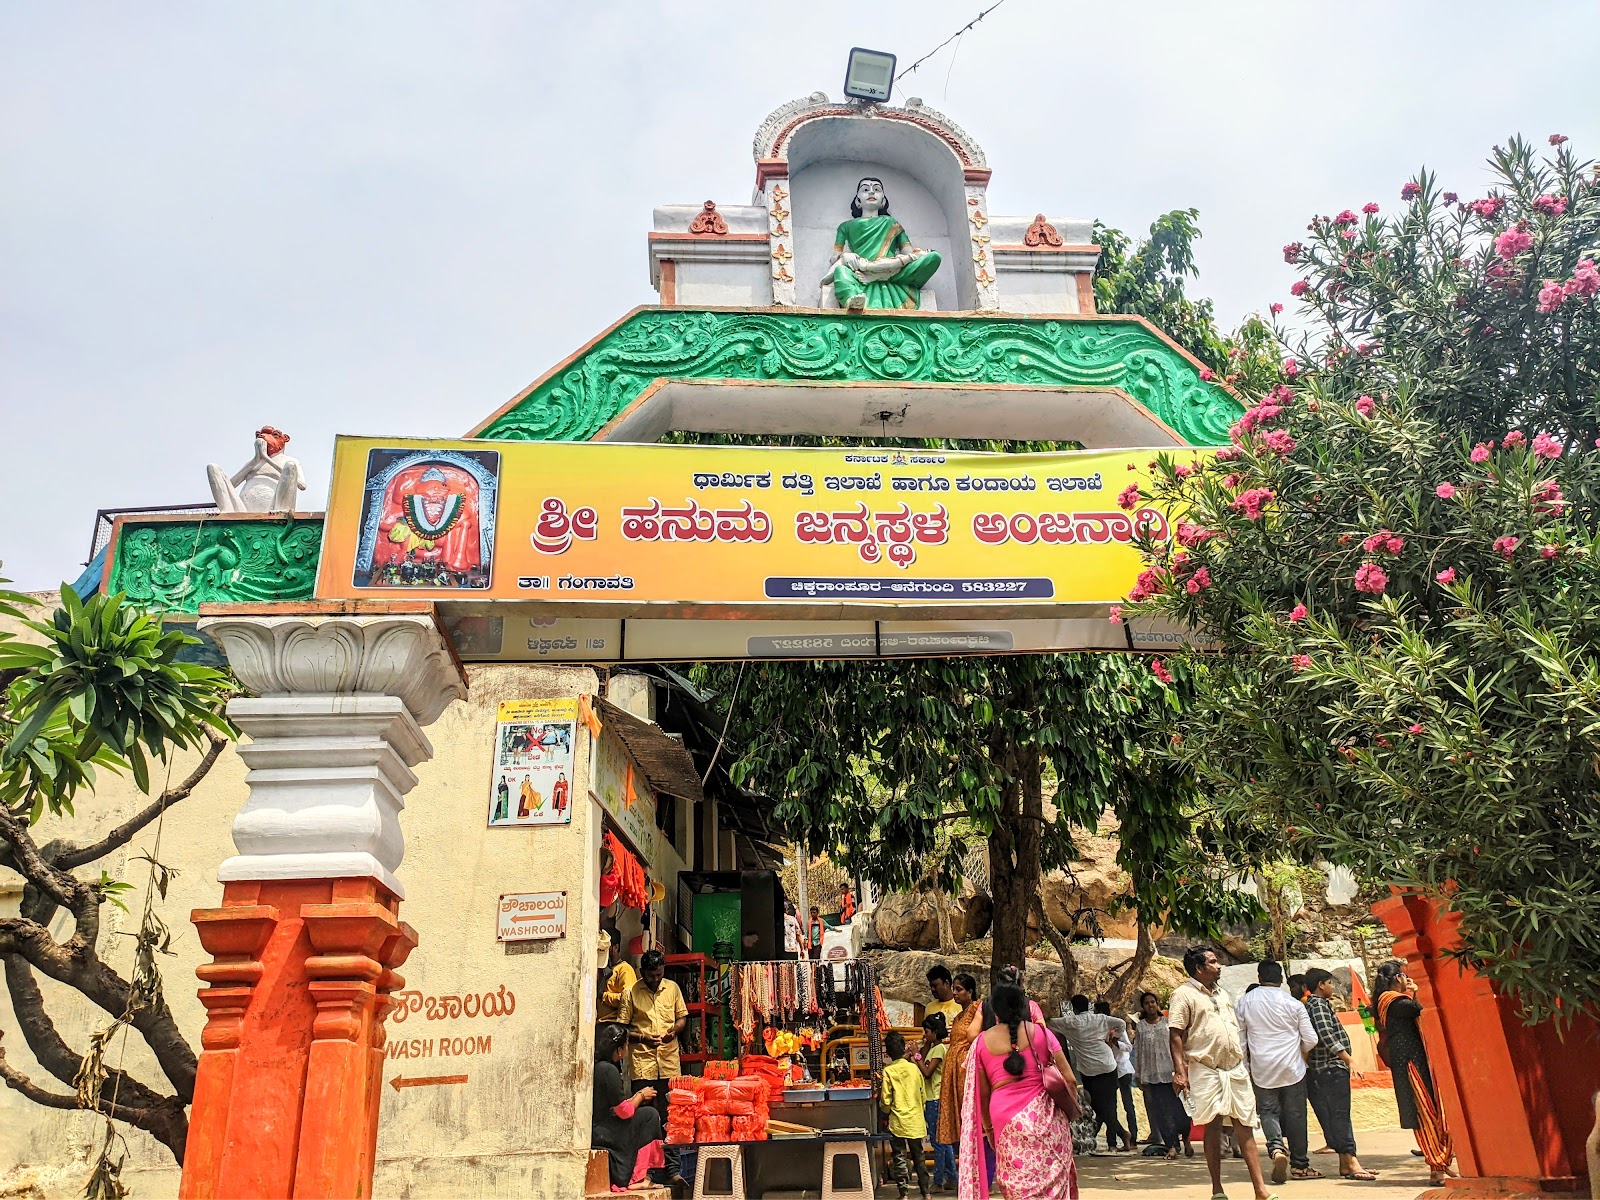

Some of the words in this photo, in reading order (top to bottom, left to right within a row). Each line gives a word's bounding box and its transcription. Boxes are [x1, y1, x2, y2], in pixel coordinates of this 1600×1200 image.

[845, 454, 888, 463] ಕರ್ನಾಟಕ
[910, 455, 946, 464] ಸರ್ಕಾರ
[693, 471, 771, 489] ಧಾರ್ಮಿಕ
[782, 472, 814, 495] ದತ್ತಿ
[824, 472, 881, 491] ಇಲಾಖೆ
[892, 474, 950, 492] ಹಾಗೂ
[956, 473, 1035, 491] ಕಂದಾಯ
[1047, 473, 1102, 491] ಇಲಾಖೆ
[531, 497, 597, 554] ಶ್ರೀ
[621, 498, 772, 542] ಹನುಮ
[796, 501, 948, 568] ಜನ್ಮಸ್ಥಳ
[558, 574, 634, 590] ಗಂಗಾವತಿ
[962, 581, 1027, 592] 583227
[531, 726, 544, 735] No
[501, 896, 564, 912] ಶೌಚಾಲಯ
[501, 924, 563, 936] WASHROOM
[384, 1039, 434, 1059] WASH
[438, 1035, 492, 1056] ROOM
